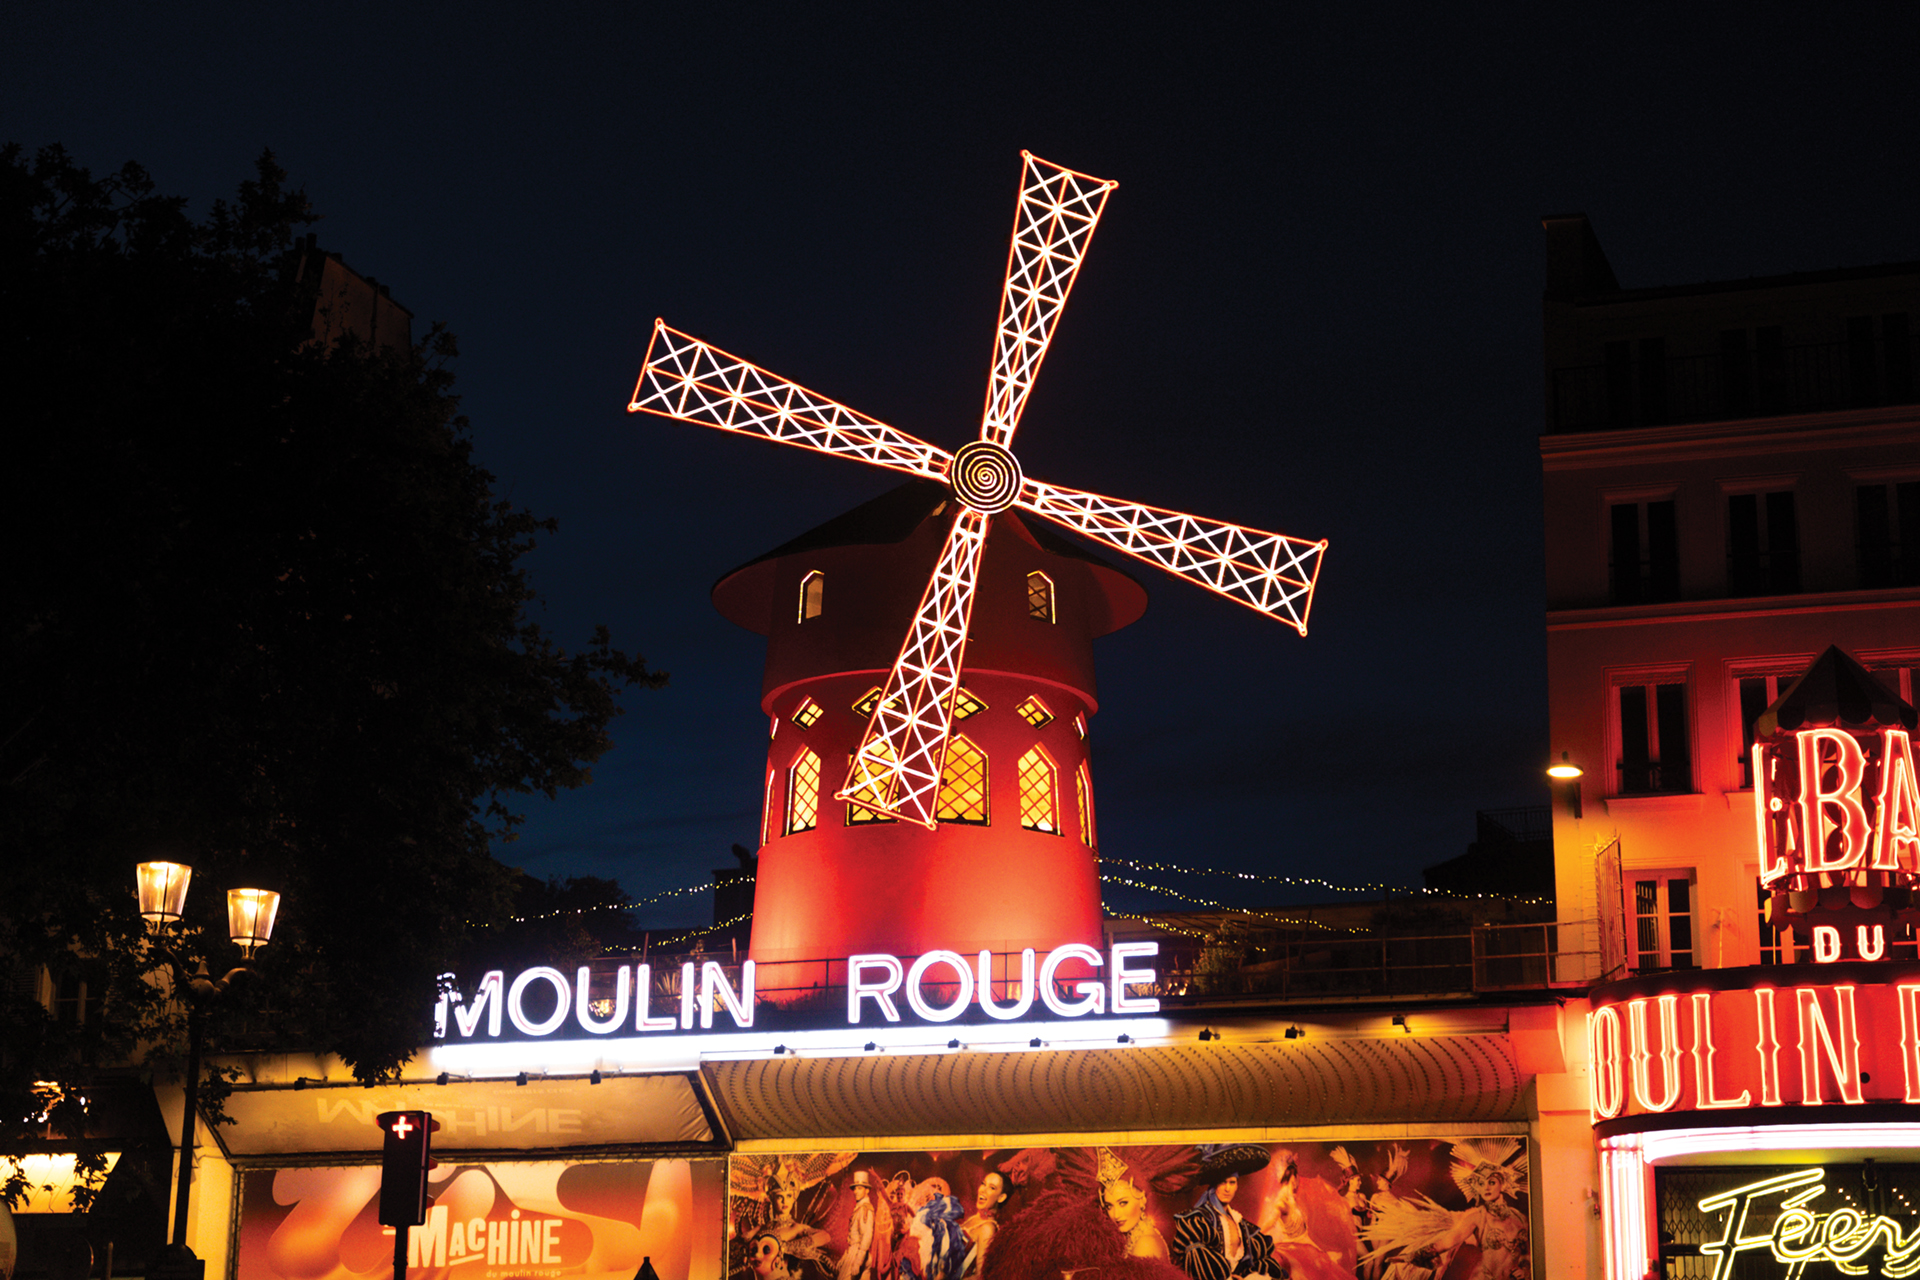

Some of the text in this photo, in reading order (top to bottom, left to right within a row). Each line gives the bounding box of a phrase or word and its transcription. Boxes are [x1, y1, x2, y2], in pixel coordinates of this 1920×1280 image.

[1812, 924, 1885, 963] DU
[434, 942, 1160, 1038] MOULIN ROUGE
[1587, 985, 1866, 1125] OULIN
[486, 1268, 562, 1278] du moulin rouge
